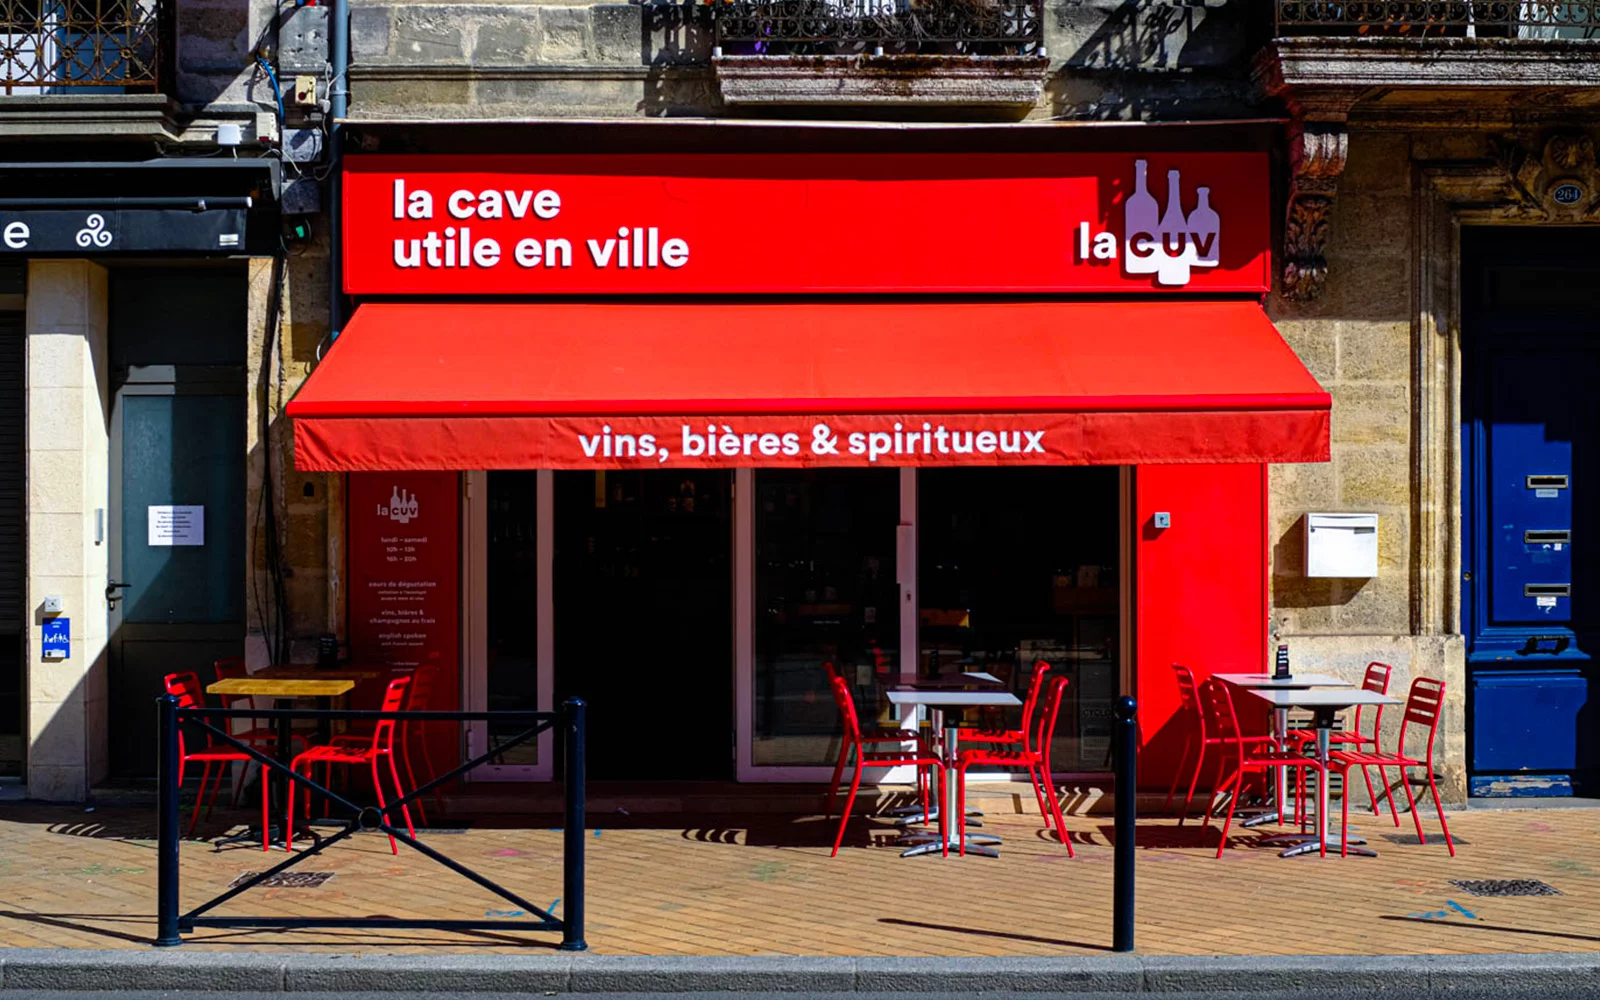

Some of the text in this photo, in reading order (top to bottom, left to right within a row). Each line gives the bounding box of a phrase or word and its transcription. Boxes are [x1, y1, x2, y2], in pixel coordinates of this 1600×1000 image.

[394, 178, 562, 219] la cave
[3, 220, 31, 249] e
[394, 226, 690, 268] utile en ville
[1080, 221, 1117, 259] la
[578, 420, 1047, 464] vins, bières & spiritueux
[376, 503, 389, 516] la
[378, 632, 402, 640] english
